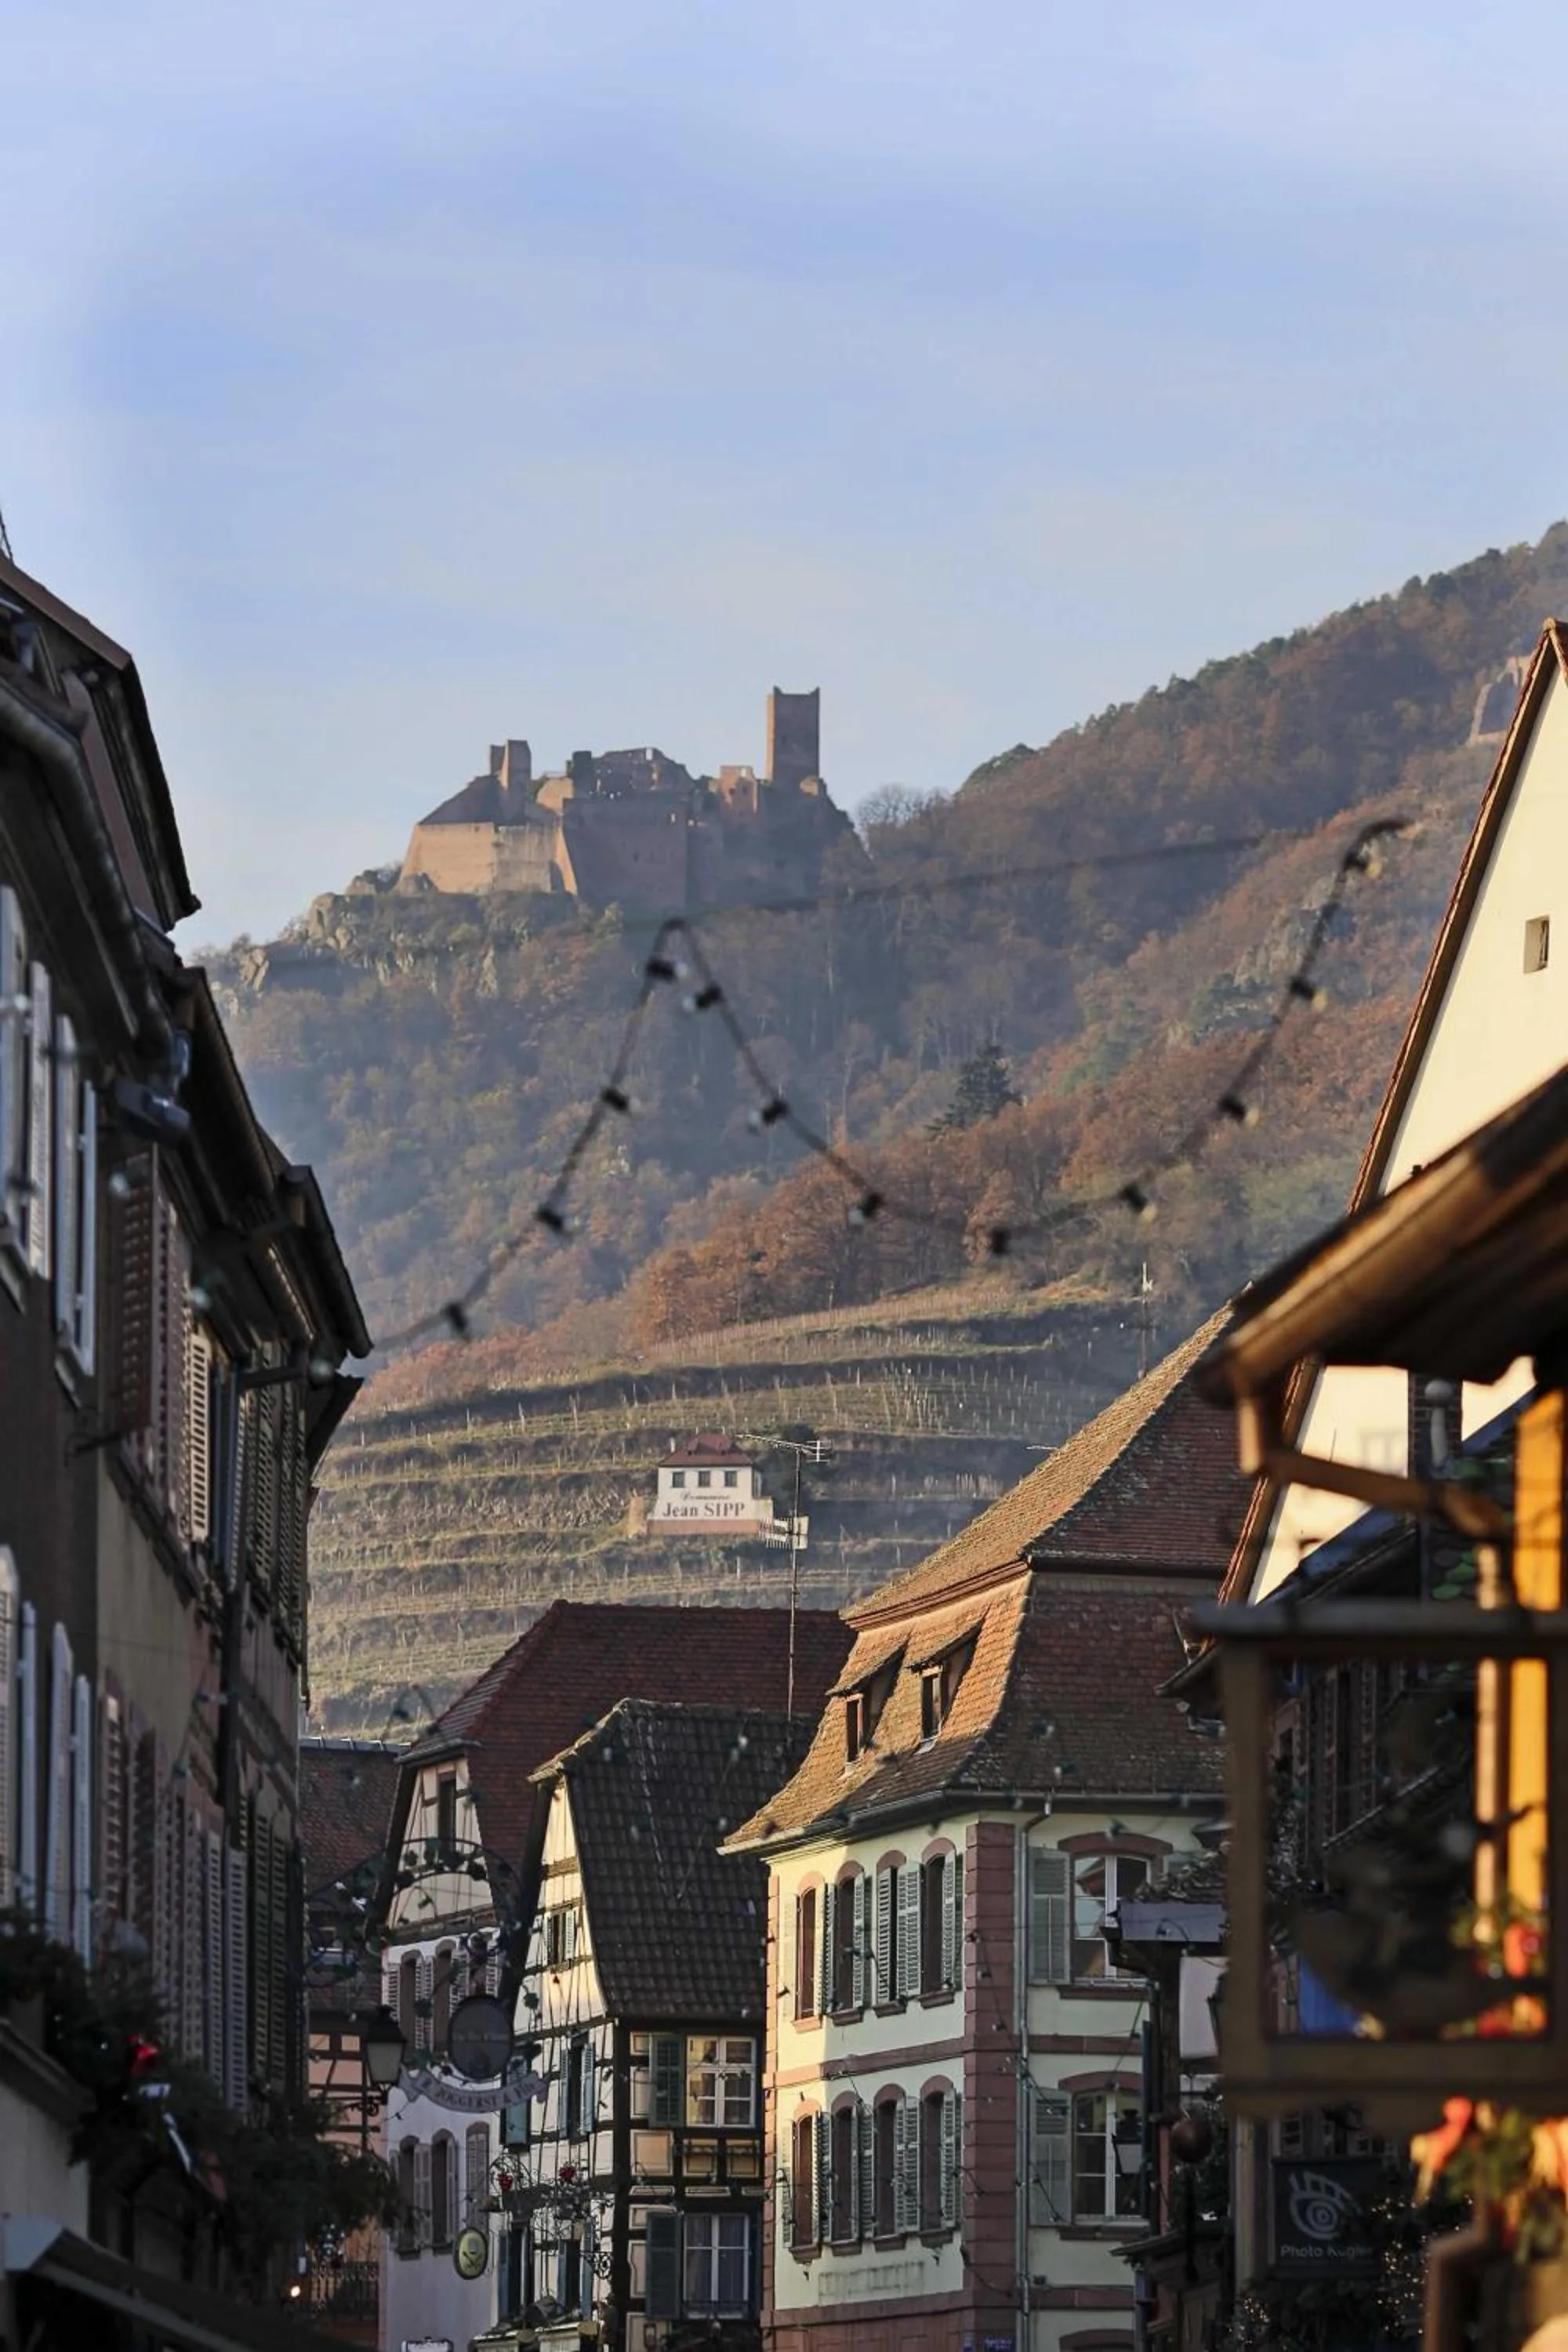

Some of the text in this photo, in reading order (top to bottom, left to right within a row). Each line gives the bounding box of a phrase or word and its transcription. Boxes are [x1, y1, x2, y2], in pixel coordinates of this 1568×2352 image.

[662, 1503, 745, 1517] Jean SIPP
[1280, 2244, 1323, 2258] Photo
